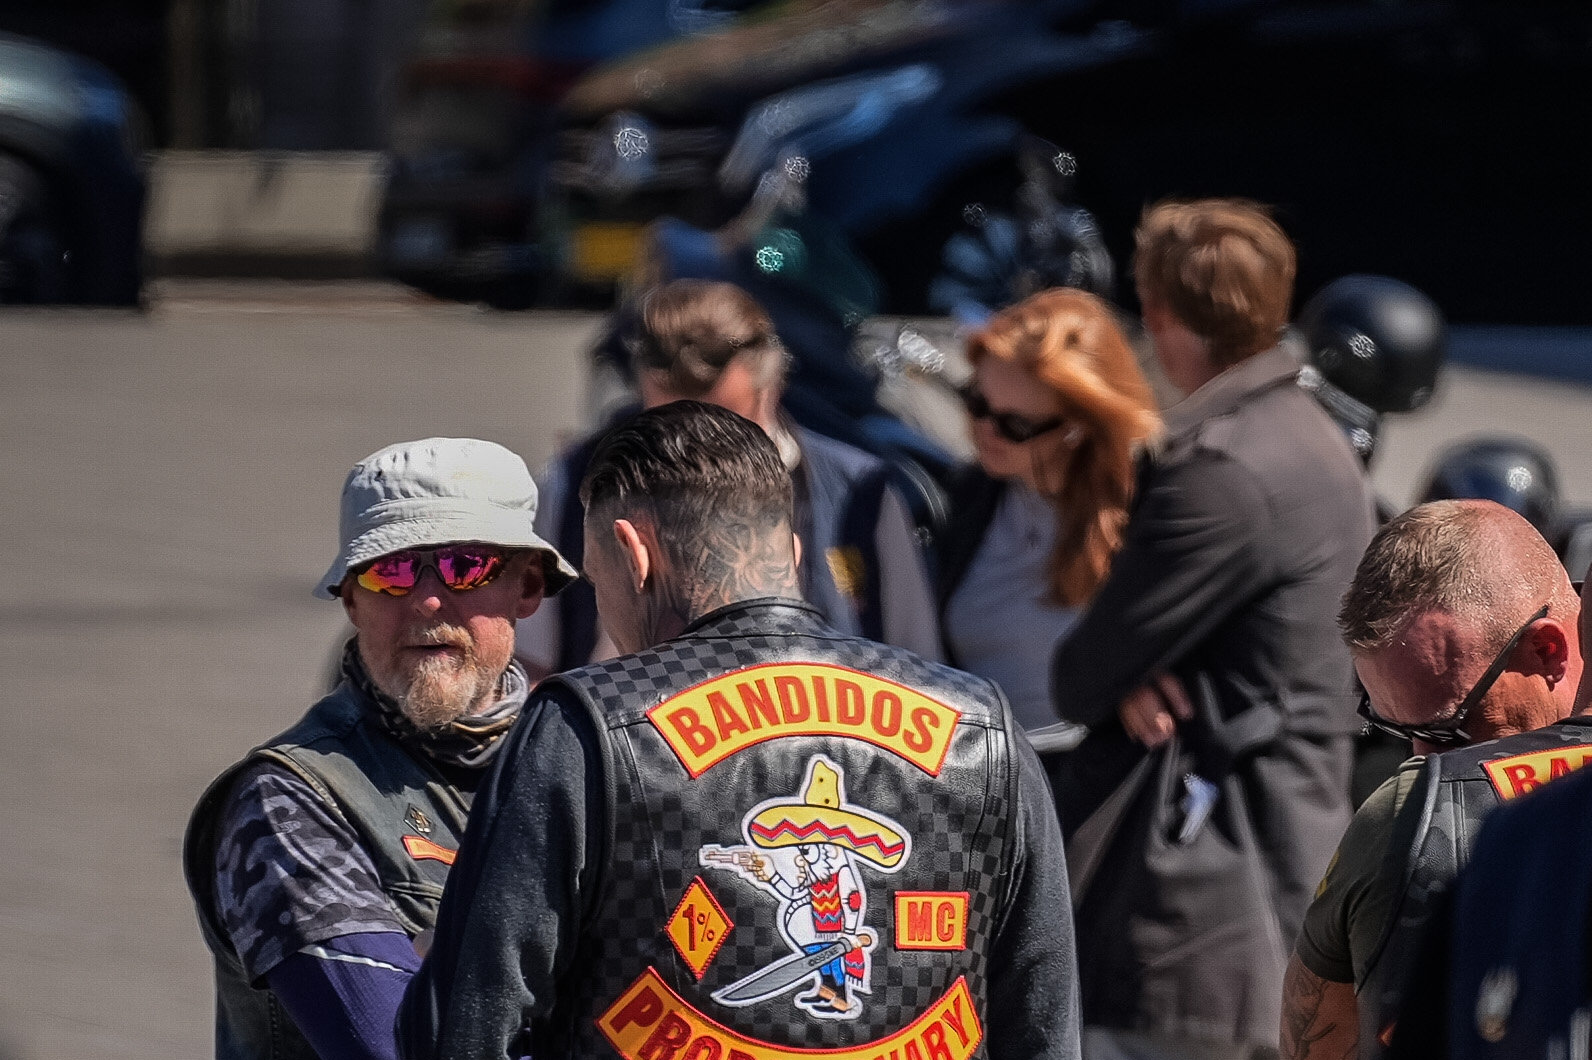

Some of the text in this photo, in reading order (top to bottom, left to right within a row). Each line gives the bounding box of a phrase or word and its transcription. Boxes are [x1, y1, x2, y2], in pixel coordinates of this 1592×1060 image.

[667, 674, 941, 758] BANDIDOS
[681, 903, 715, 952] 1%
[907, 901, 955, 942] MC
